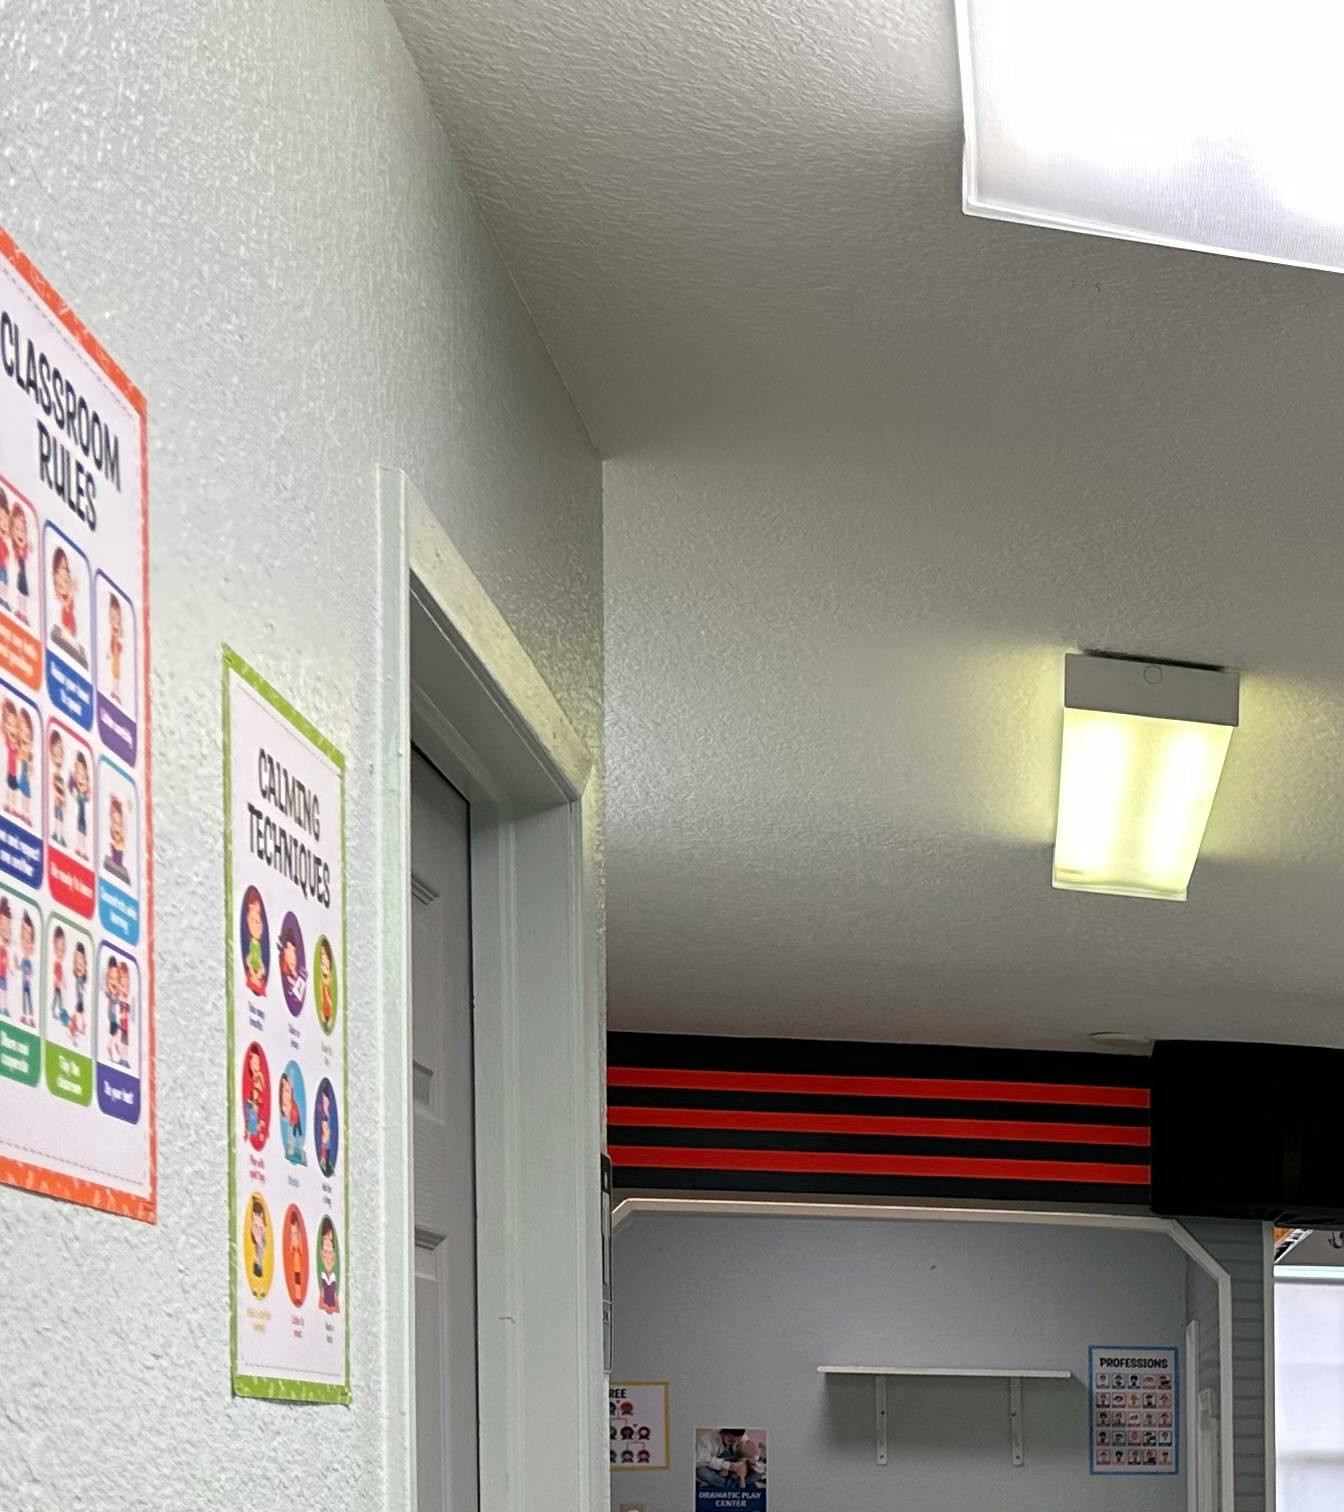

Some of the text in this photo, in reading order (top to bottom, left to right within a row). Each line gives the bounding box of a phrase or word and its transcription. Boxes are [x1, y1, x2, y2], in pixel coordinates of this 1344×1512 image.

[1, 311, 121, 493] CLASSROOM
[37, 418, 97, 532] RULES
[258, 748, 320, 842] CALMING
[247, 801, 330, 909] TECHNIQUES
[609, 1388, 627, 1399] REE
[1099, 1357, 1169, 1369] PROFESSIONS
[699, 1491, 762, 1499] DRAMATIC PLAY
